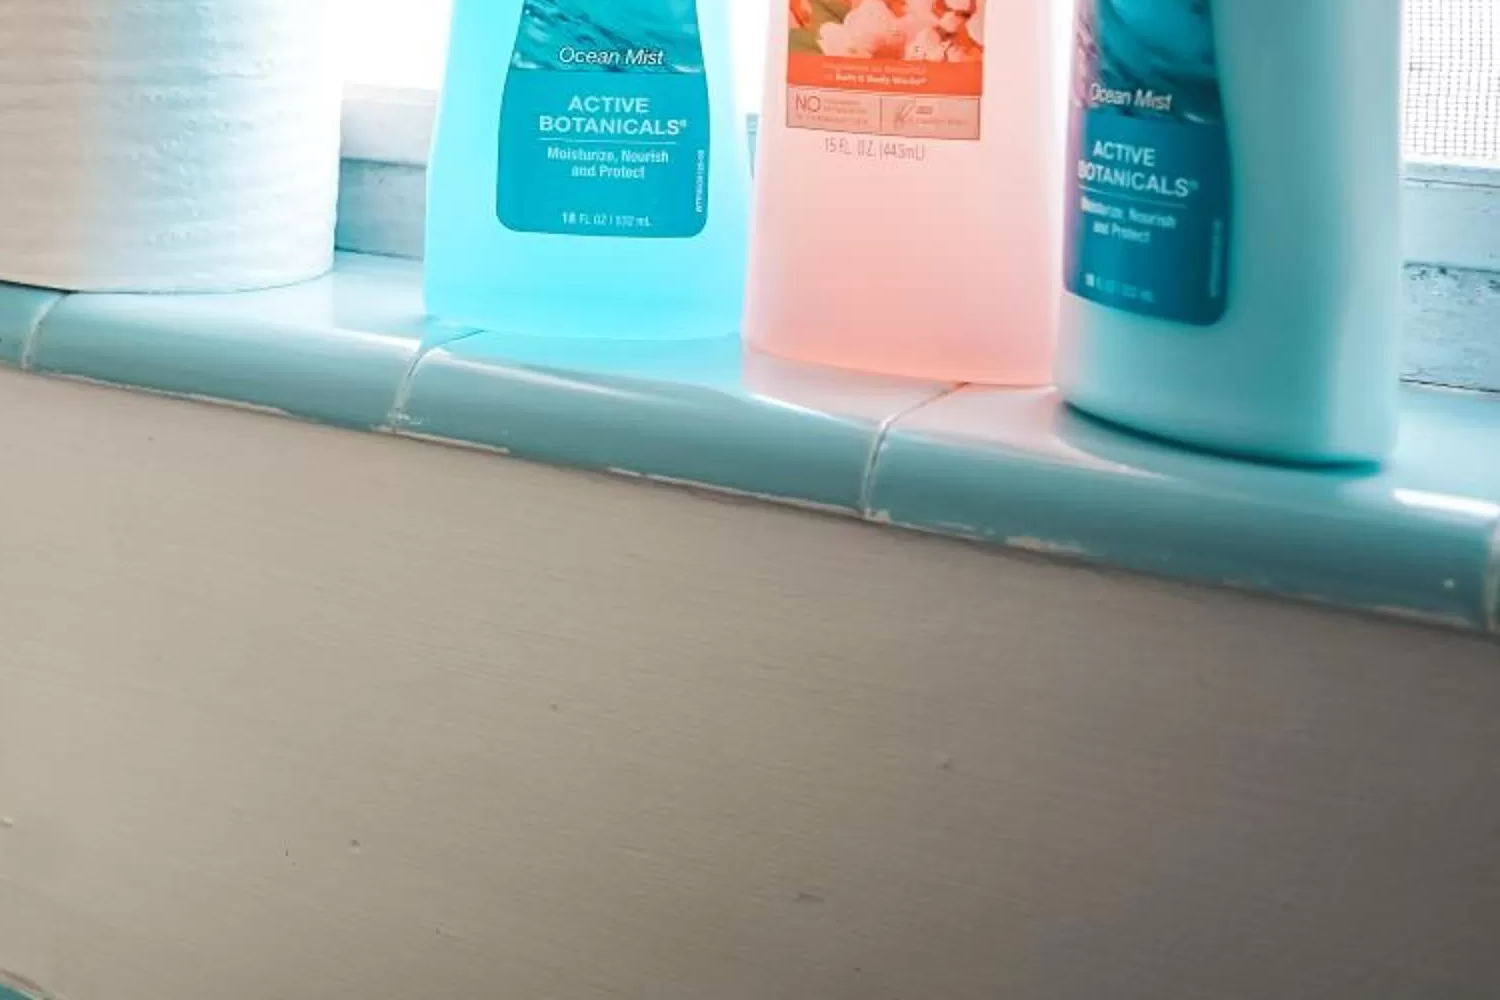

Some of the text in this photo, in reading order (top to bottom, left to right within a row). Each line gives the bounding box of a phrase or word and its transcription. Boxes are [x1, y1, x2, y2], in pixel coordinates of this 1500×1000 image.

[559, 47, 665, 66] Ocean Mist
[568, 95, 649, 114] ACTIVE
[796, 93, 821, 112] NO
[1091, 82, 1173, 111] Ocean Mist
[621, 149, 669, 164] Nourish
[1092, 139, 1156, 168] ACTIVE
[571, 165, 645, 179] and Protect
